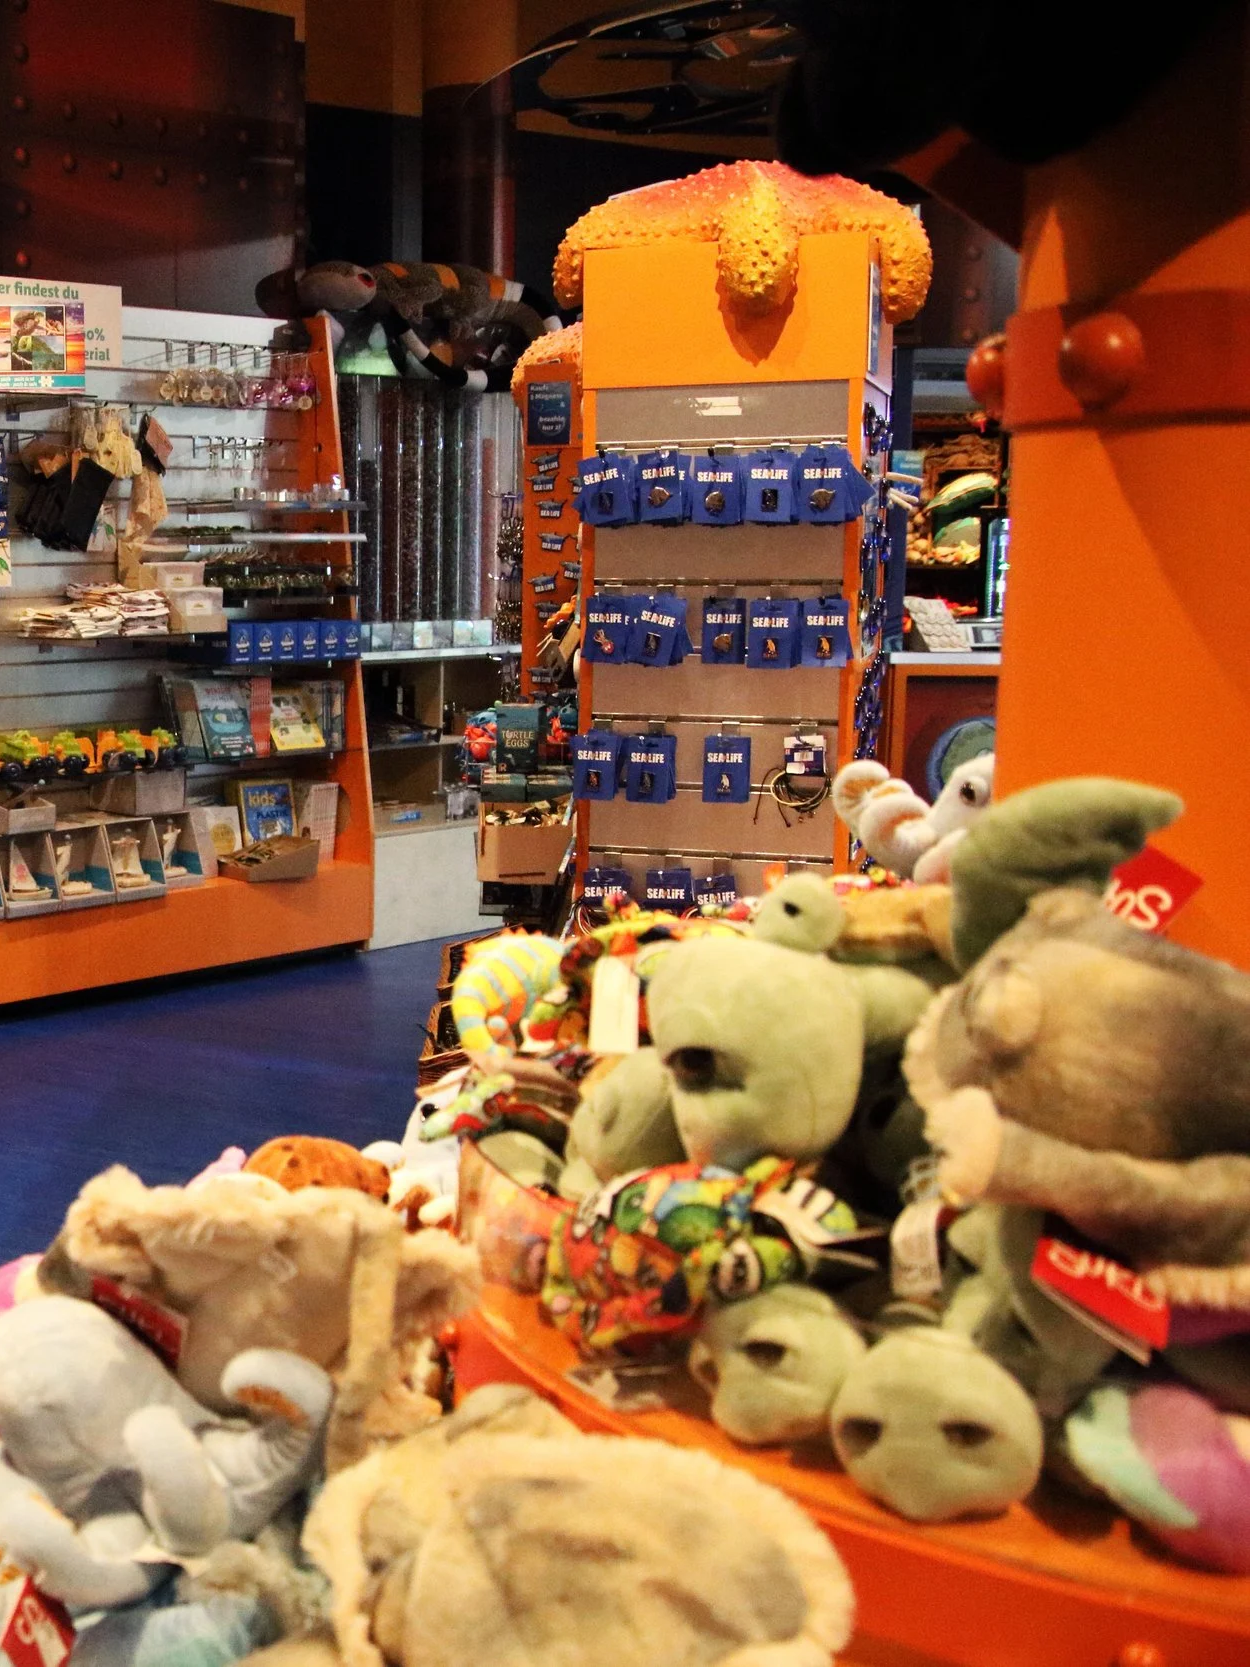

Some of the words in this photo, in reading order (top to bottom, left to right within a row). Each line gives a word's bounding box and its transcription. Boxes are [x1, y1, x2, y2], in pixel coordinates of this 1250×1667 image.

[14, 281, 59, 299] findest
[63, 286, 79, 300] du
[86, 328, 105, 342] 0%
[84, 347, 110, 361] erial
[583, 472, 600, 485] SEA
[642, 469, 657, 479] SEA
[697, 472, 713, 482] SEA
[751, 468, 768, 479] SEA
[804, 468, 821, 479] SEA
[589, 613, 604, 623] SEA
[641, 610, 658, 622] SEA
[706, 614, 722, 624] SEA
[807, 615, 825, 626] SEA
[752, 617, 770, 628] SEA
[502, 730, 534, 740] TURTLE
[505, 740, 529, 748] EGGS
[578, 750, 593, 760] SEA
[631, 752, 647, 762] SEA
[707, 752, 724, 763] SEA
[248, 790, 276, 808] kids
[584, 887, 601, 898] SEA
[647, 888, 664, 899] SEA
[698, 894, 715, 905] SEA
